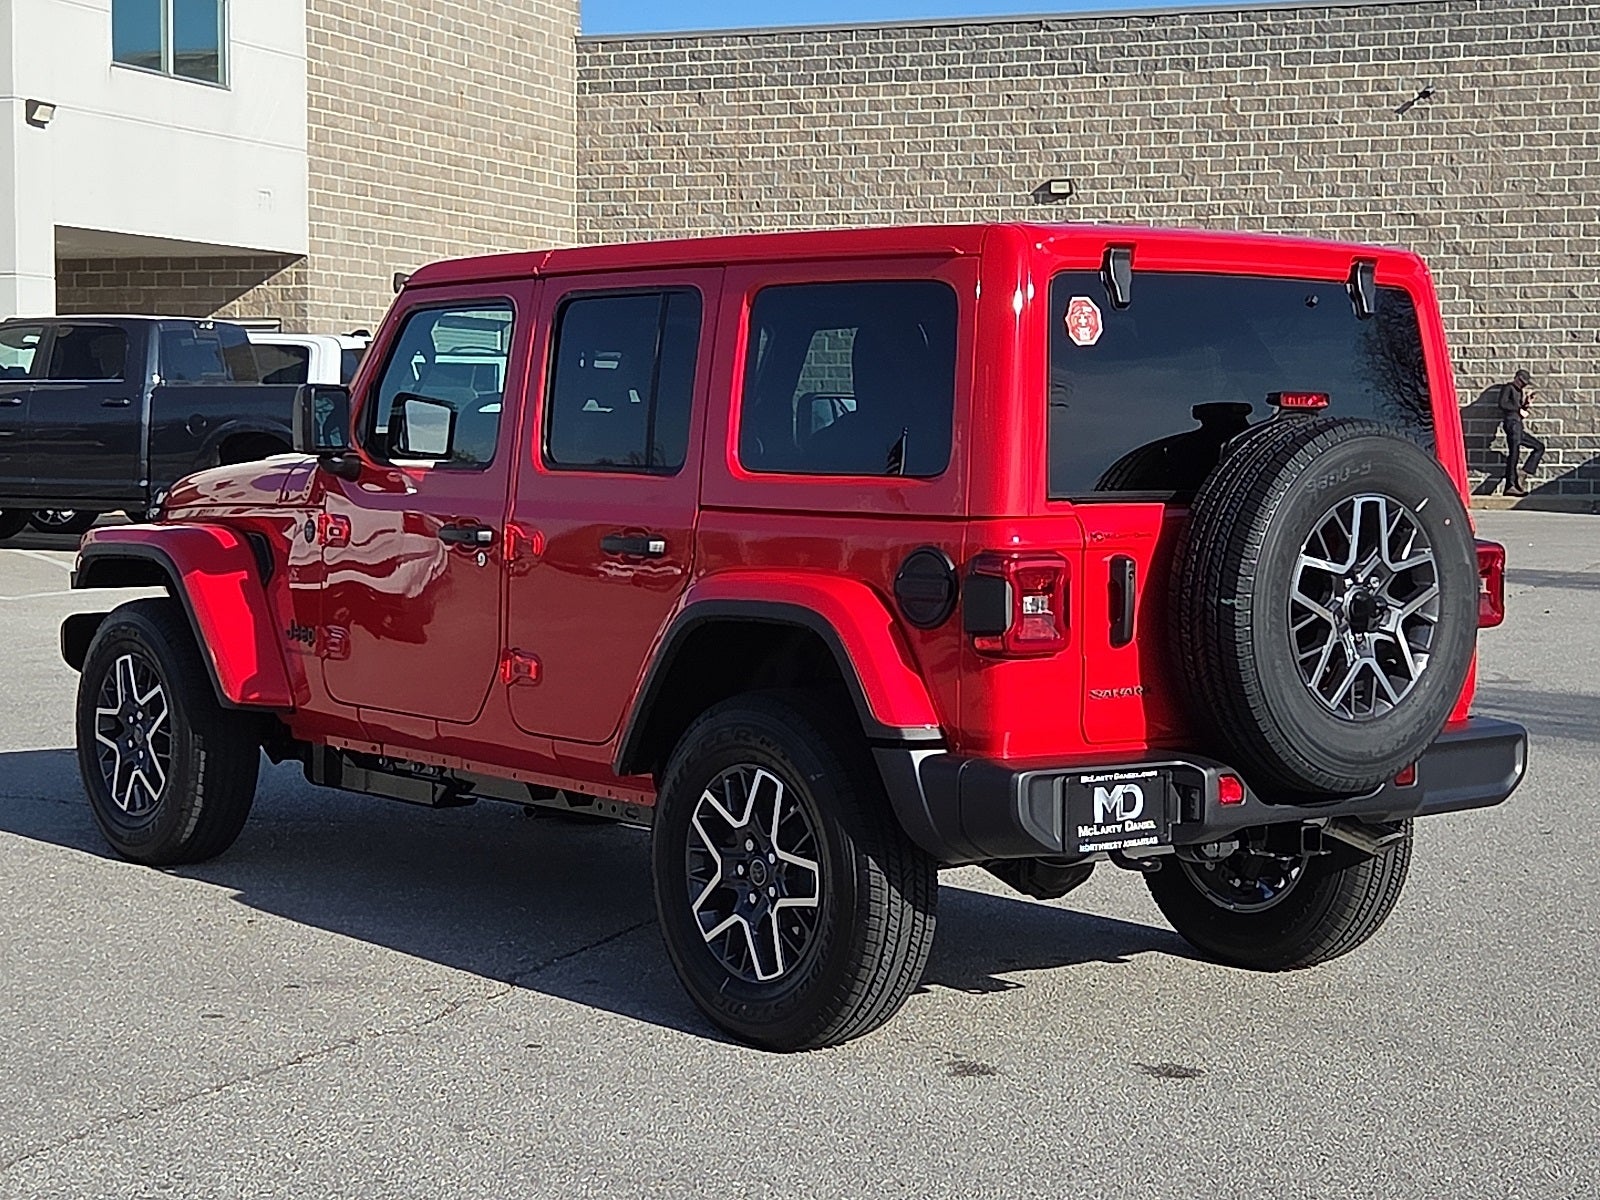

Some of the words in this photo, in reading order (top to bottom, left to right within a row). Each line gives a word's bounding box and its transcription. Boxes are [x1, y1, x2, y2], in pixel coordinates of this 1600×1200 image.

[286, 619, 316, 647] Jeep
[1089, 684, 1146, 700] SAHAR
[1093, 783, 1144, 823] MD
